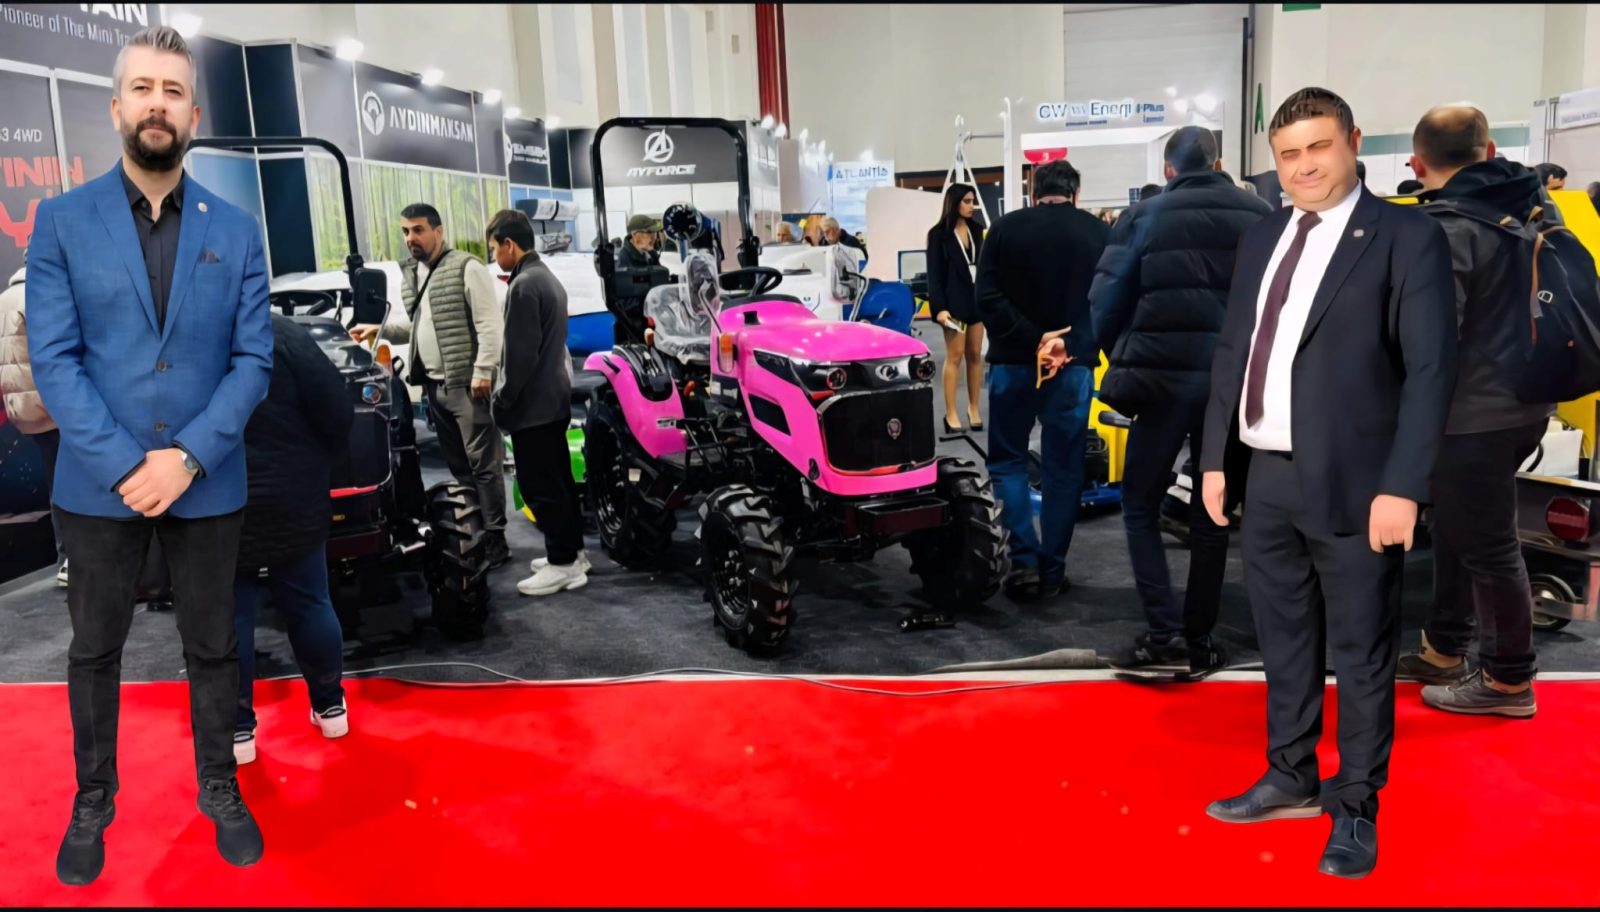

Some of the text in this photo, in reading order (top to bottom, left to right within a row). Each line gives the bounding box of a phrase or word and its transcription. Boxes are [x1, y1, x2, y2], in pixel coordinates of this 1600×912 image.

[0, 4, 44, 29] ioneer
[48, 14, 60, 33] of
[62, 16, 84, 38] The
[87, 22, 113, 44] Mini
[80, 3, 148, 27] AIN
[13, 128, 43, 143] 4WD
[389, 105, 474, 143] AYDINMAKSAN
[626, 164, 697, 177] AYFORCE
